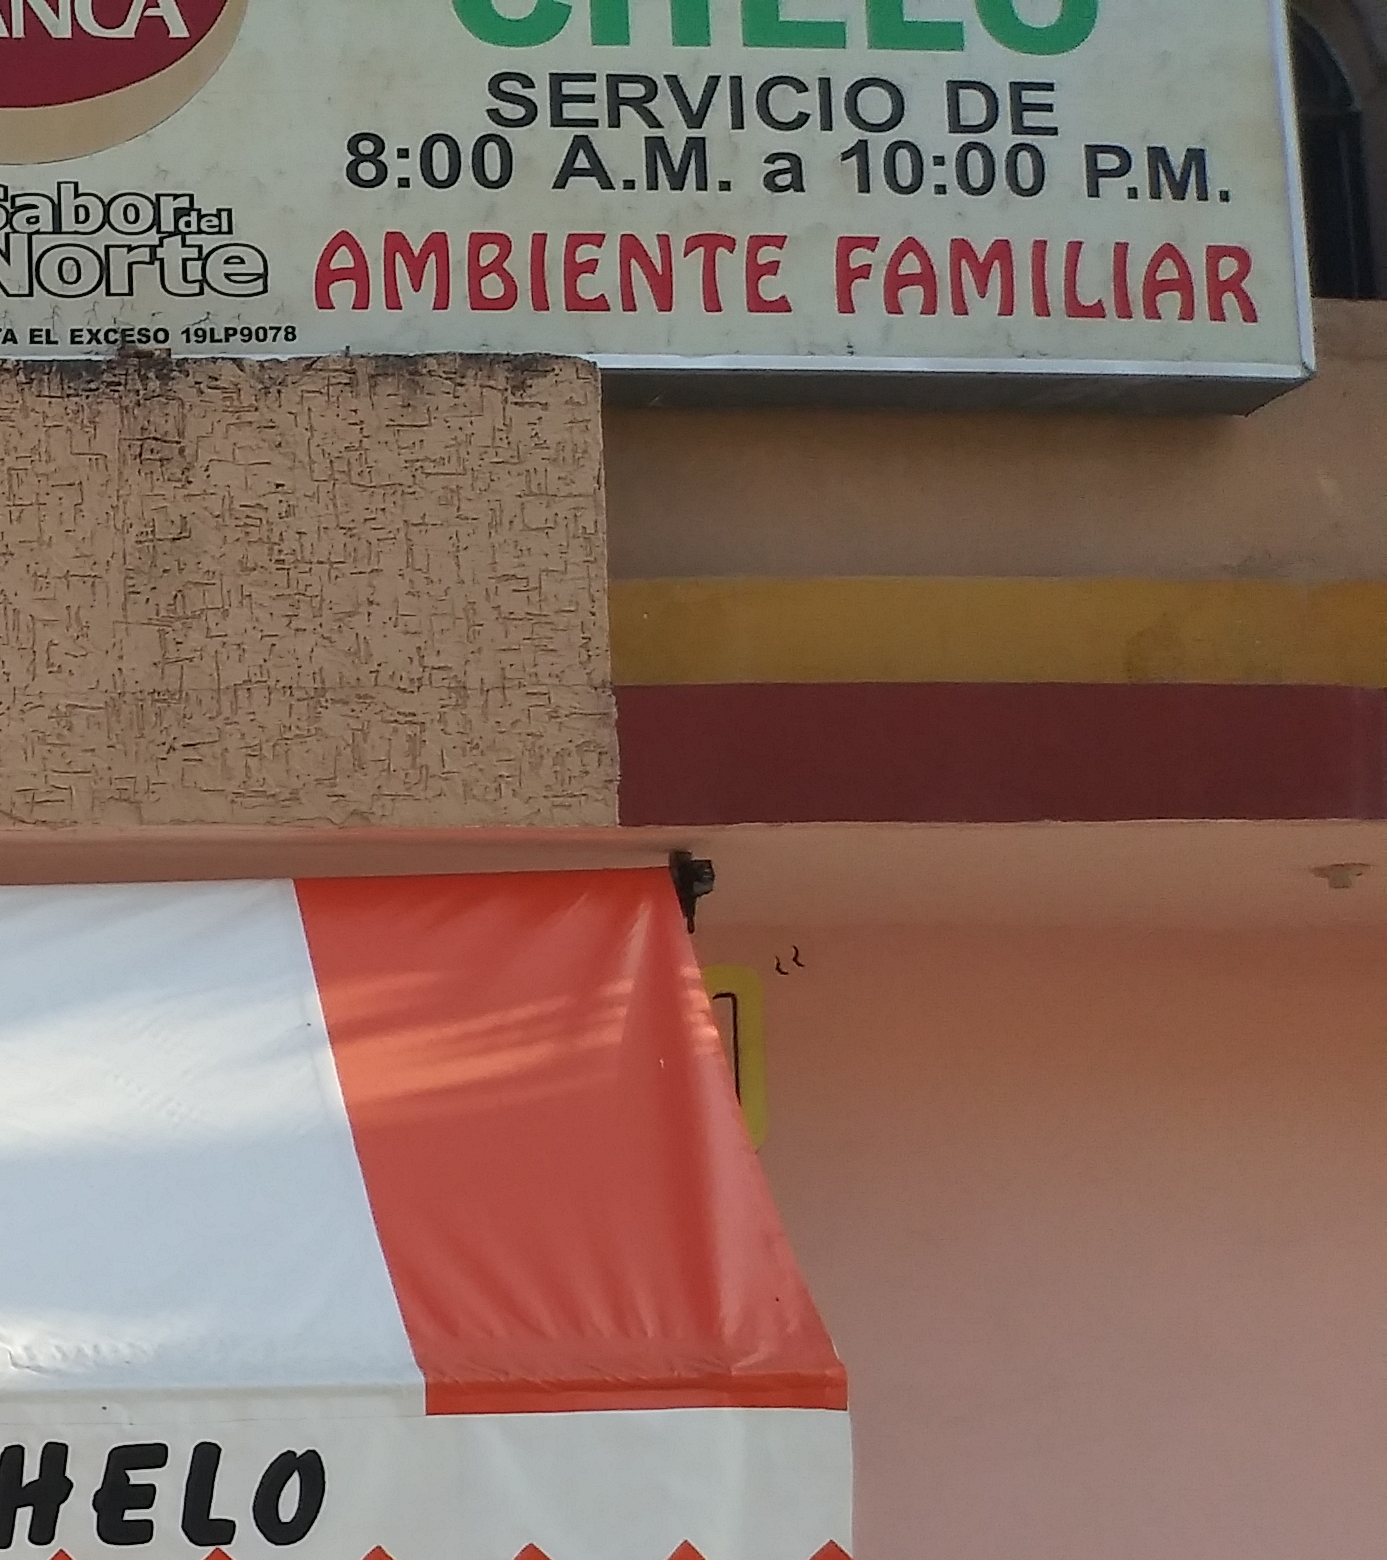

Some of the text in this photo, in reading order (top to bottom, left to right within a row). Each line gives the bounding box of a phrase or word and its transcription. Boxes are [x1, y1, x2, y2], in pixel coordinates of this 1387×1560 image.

[485, 72, 1060, 137] SERVICIO DE
[344, 132, 1233, 203] 8:00 A.M. a 10:00 P.M.
[176, 207, 233, 235] del
[313, 229, 1261, 324] AMBIENTE FAMILIAR
[28, 326, 59, 345] EL
[69, 326, 171, 345] EXCESO
[181, 325, 298, 345] 19LP9078
